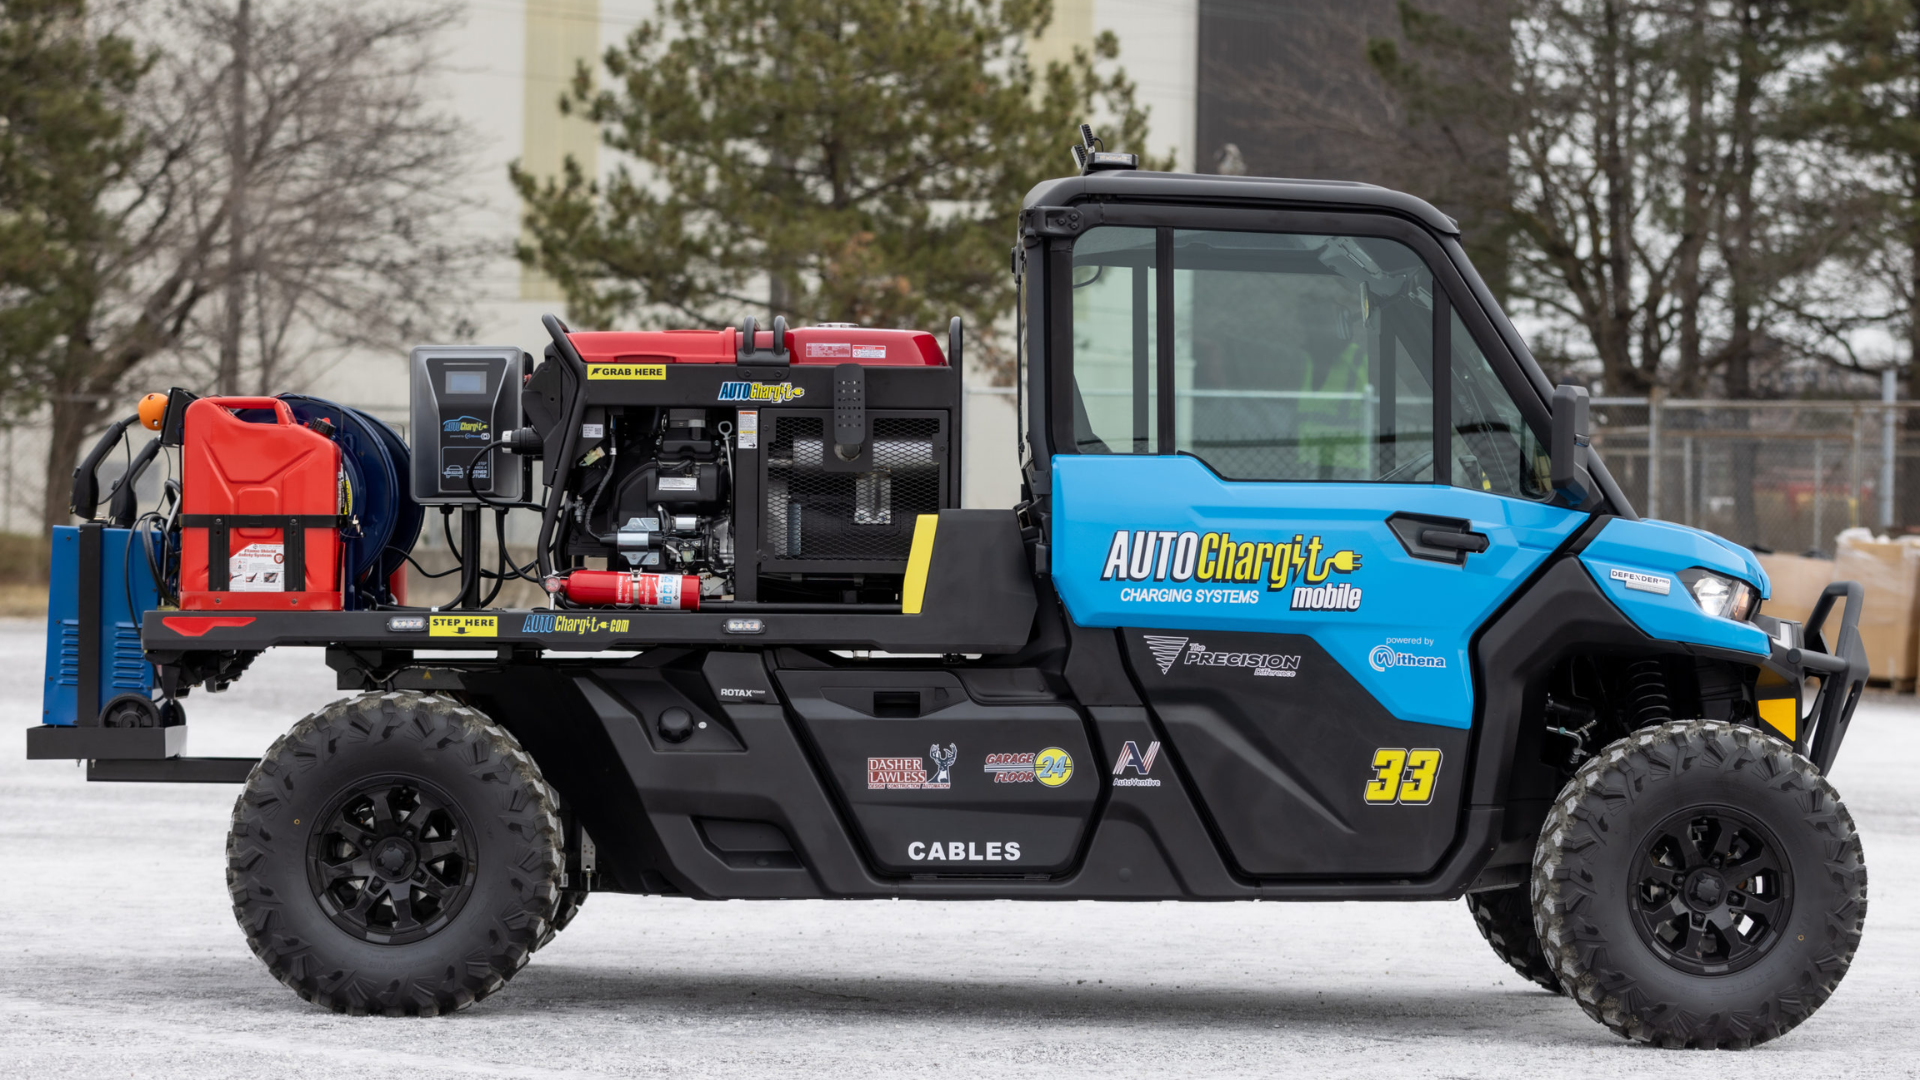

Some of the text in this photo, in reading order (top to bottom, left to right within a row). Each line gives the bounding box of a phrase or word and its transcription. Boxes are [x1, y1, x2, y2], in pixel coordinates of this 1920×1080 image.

[602, 368, 662, 376] GRAB HERE
[1611, 570, 1659, 584] DEFENDER
[1120, 588, 1260, 604] CHARGING SYSTEMS
[1289, 582, 1363, 611] mobile
[432, 618, 495, 627] STEP HERE
[1189, 643, 1206, 652] The
[1386, 637, 1434, 647] powered by
[1184, 652, 1301, 669] PRECISION
[1254, 668, 1297, 677] Difference
[721, 688, 752, 697] ROTAX
[870, 759, 921, 770] DASHER
[985, 753, 1035, 765] GARAGE
[1039, 755, 1068, 778] 24
[870, 771, 926, 783] LAWLESS
[994, 771, 1035, 783] FLOOR
[1112, 778, 1161, 787] AutoVentive
[1364, 748, 1443, 805] 33
[907, 841, 1021, 861] CABLES
